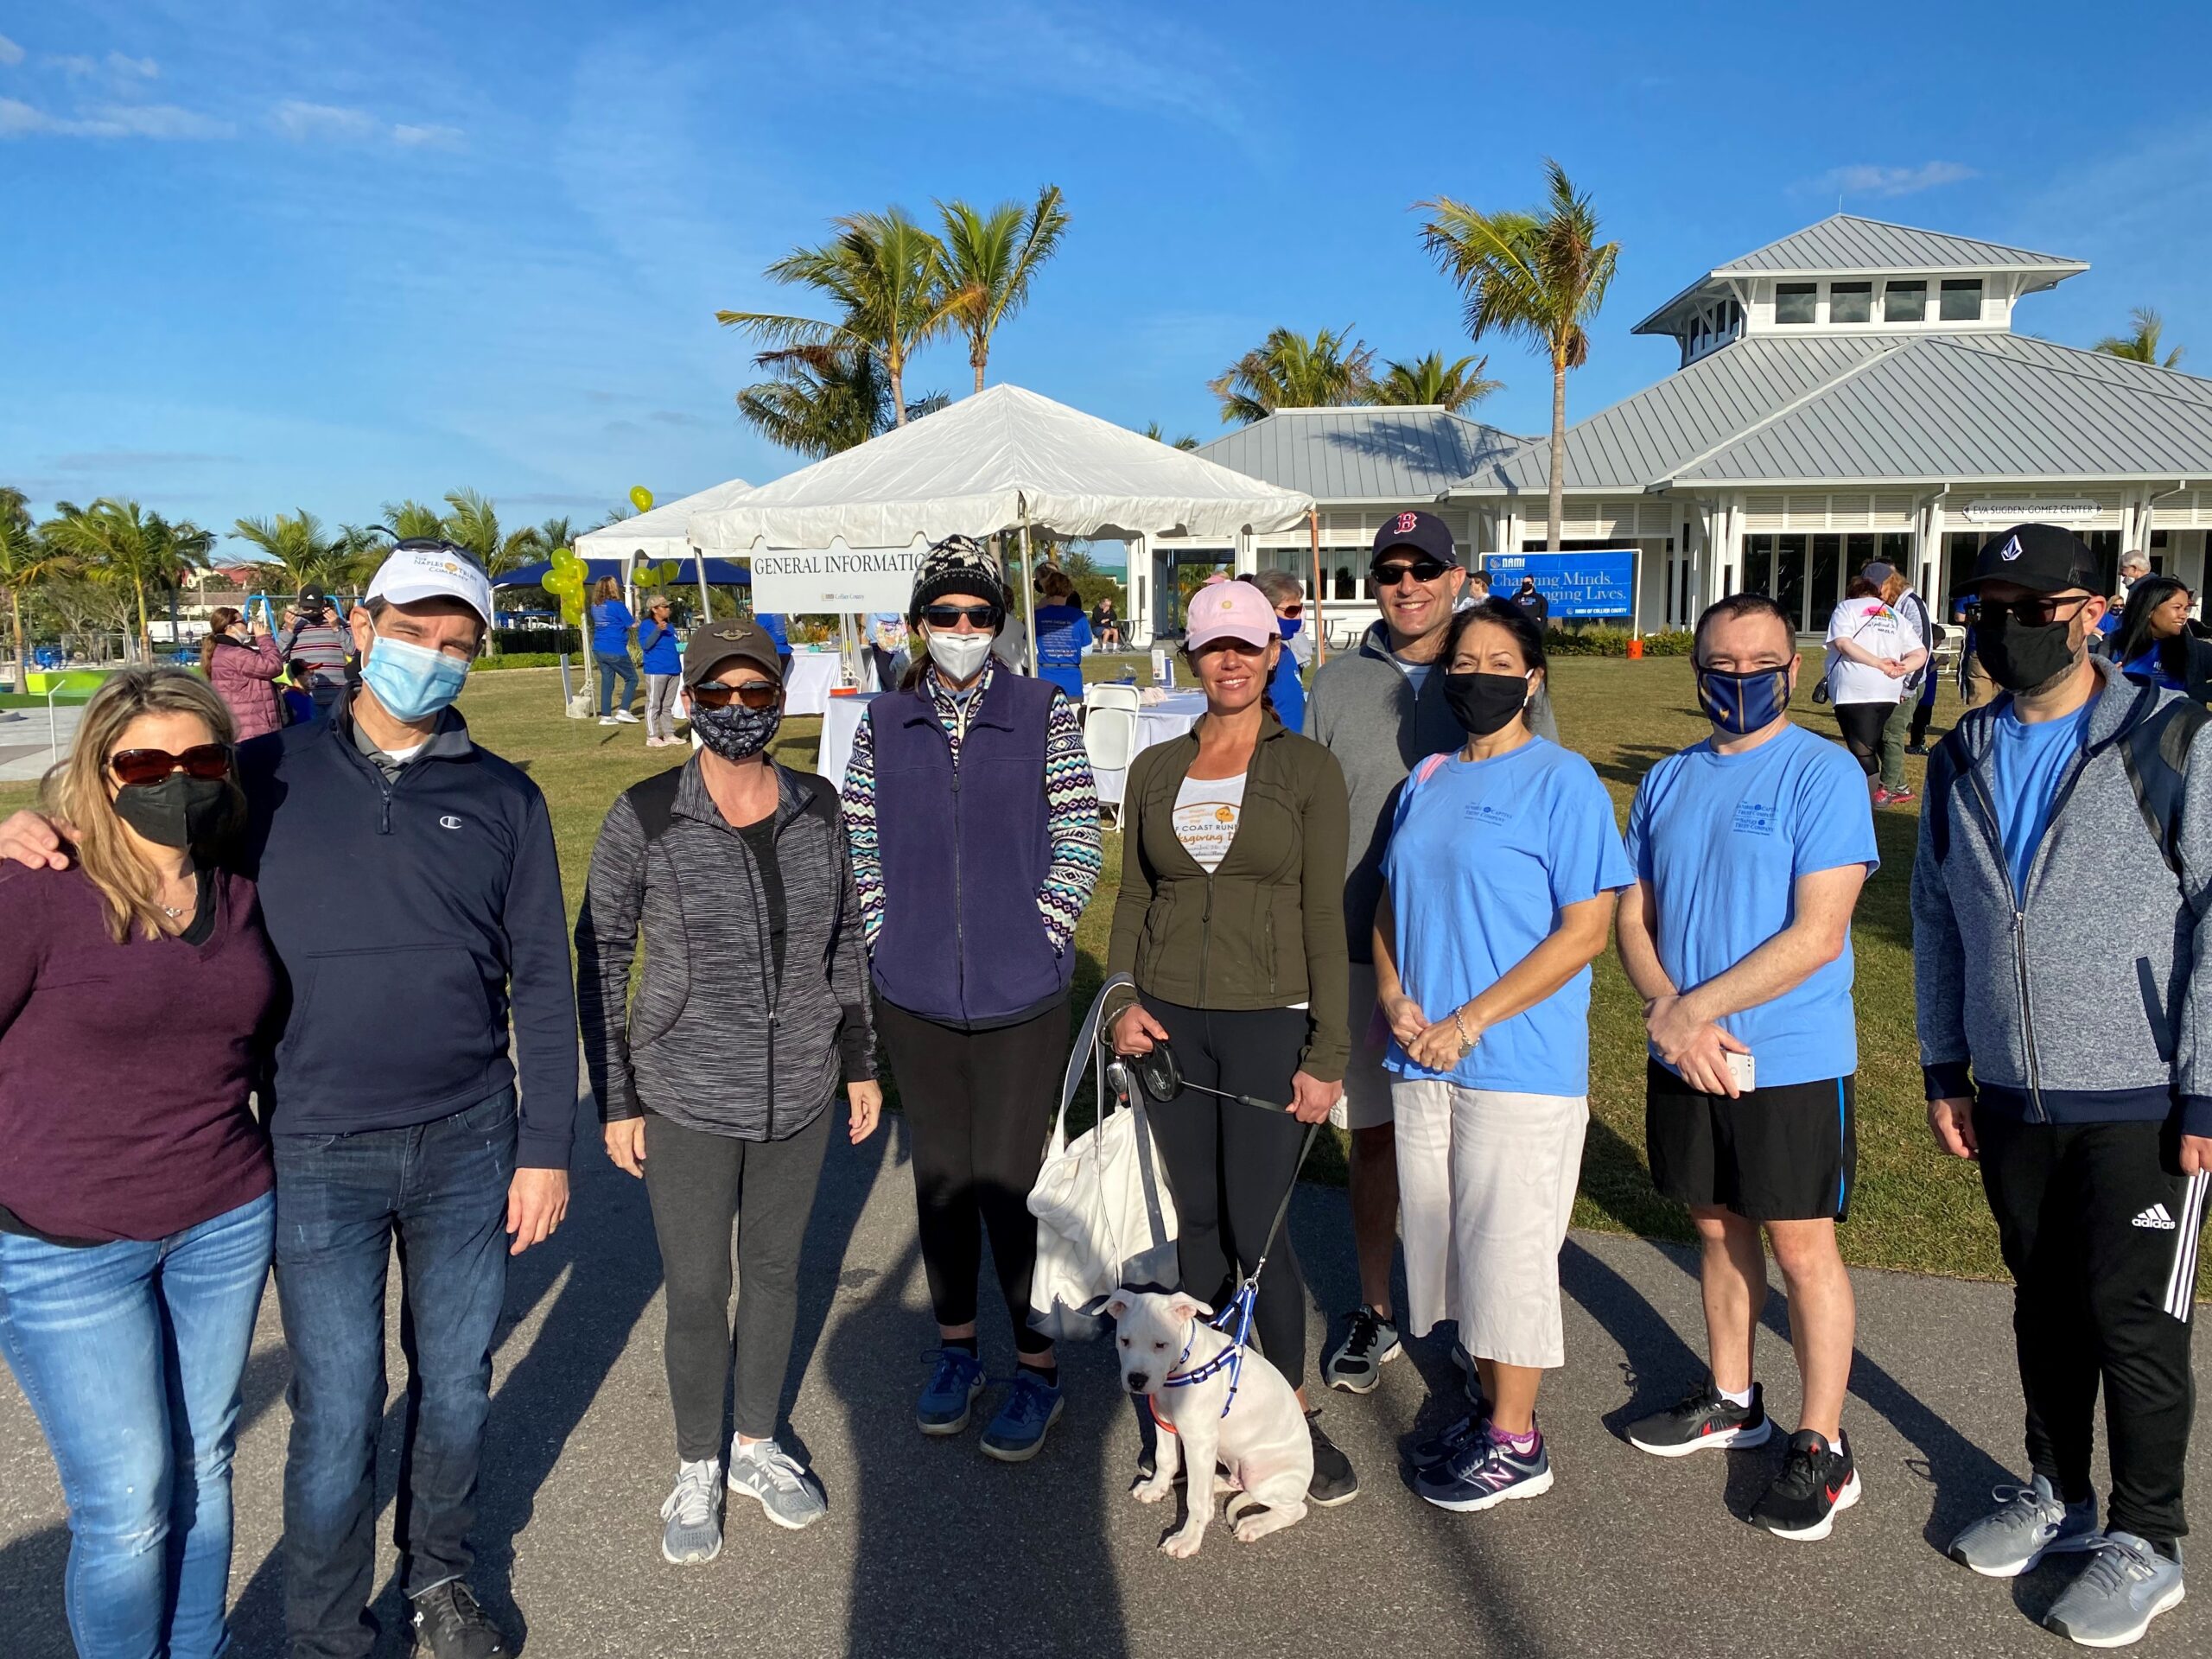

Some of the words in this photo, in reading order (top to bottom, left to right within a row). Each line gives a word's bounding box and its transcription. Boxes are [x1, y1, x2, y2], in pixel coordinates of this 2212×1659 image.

[1973, 505, 1988, 514] EVA
[1990, 505, 2058, 514] SUGDEN-GOMEZ
[2060, 505, 2093, 513] CENTER
[1394, 512, 1417, 535] B
[754, 556, 822, 575] GENERAL
[825, 553, 925, 574] INFORMATIO
[1502, 557, 1526, 569] NAMI
[429, 566, 469, 582] COMPANY
[1491, 573, 1560, 589] Chaing
[1563, 571, 1613, 586] Minds.
[1586, 586, 1626, 601] Lives.
[2132, 1217, 2176, 1230] adidas
